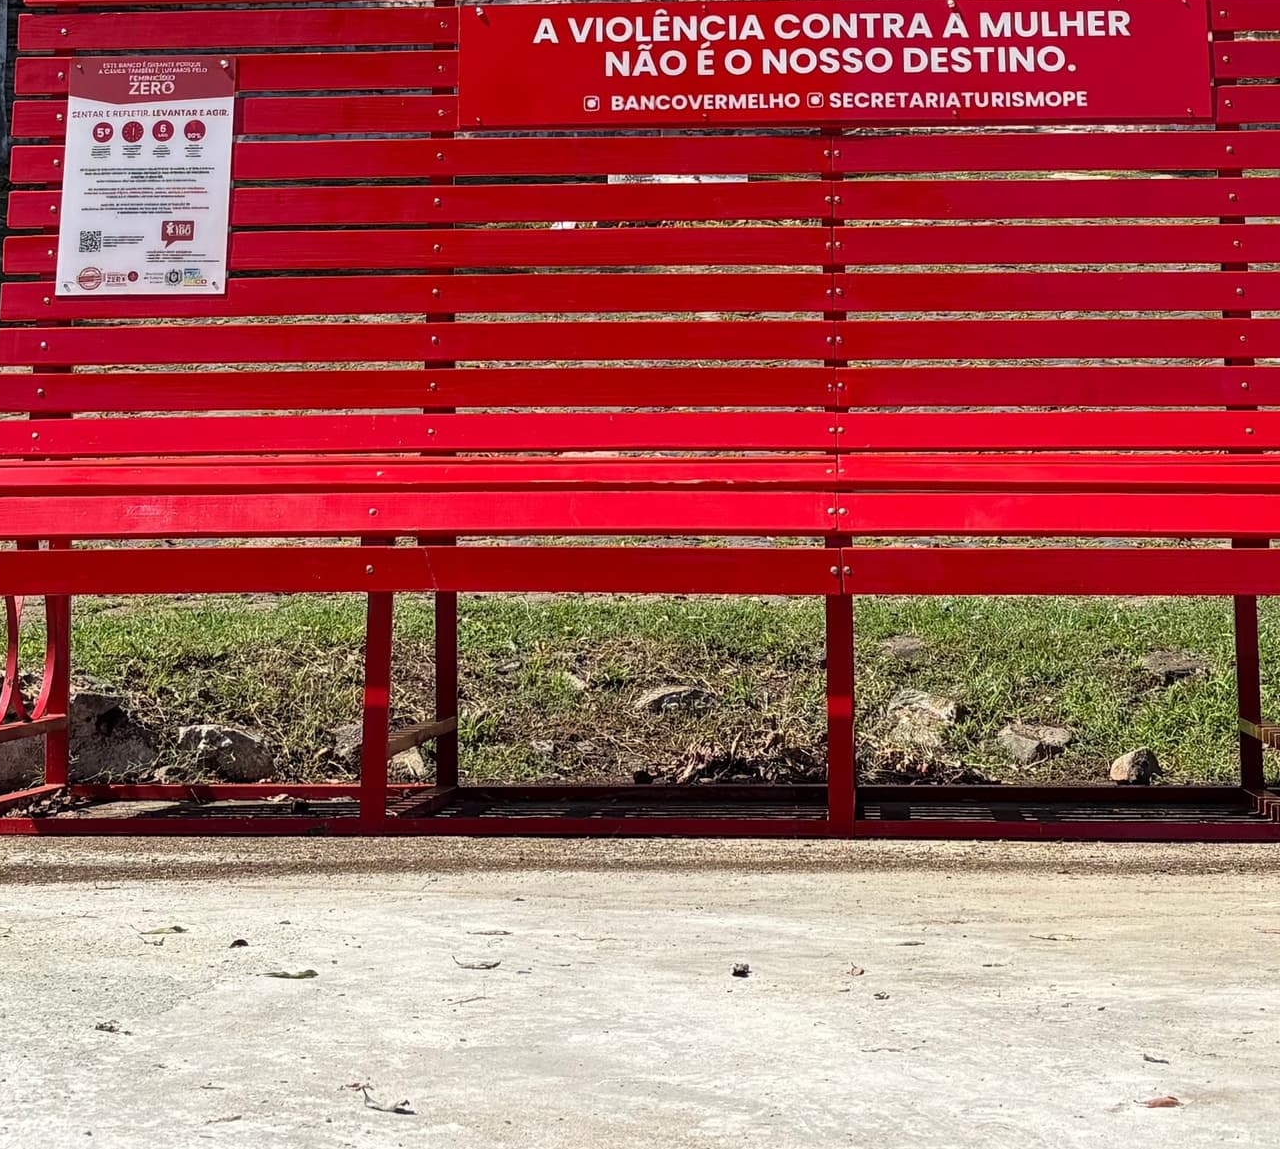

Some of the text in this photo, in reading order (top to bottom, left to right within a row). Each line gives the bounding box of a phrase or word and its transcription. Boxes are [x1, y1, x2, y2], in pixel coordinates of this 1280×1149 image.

[533, 18, 559, 43] A
[568, 9, 765, 43] VIOLÊNCIA
[774, 12, 933, 40] CONTRA
[980, 11, 1131, 38] MULHER
[606, 41, 1076, 77] NÃO É O NOSSO DESTINO.
[128, 81, 175, 95] ZERO
[611, 92, 801, 111] BANCOVERMELHO
[829, 91, 1088, 109] SECRETARIATURISMOPE
